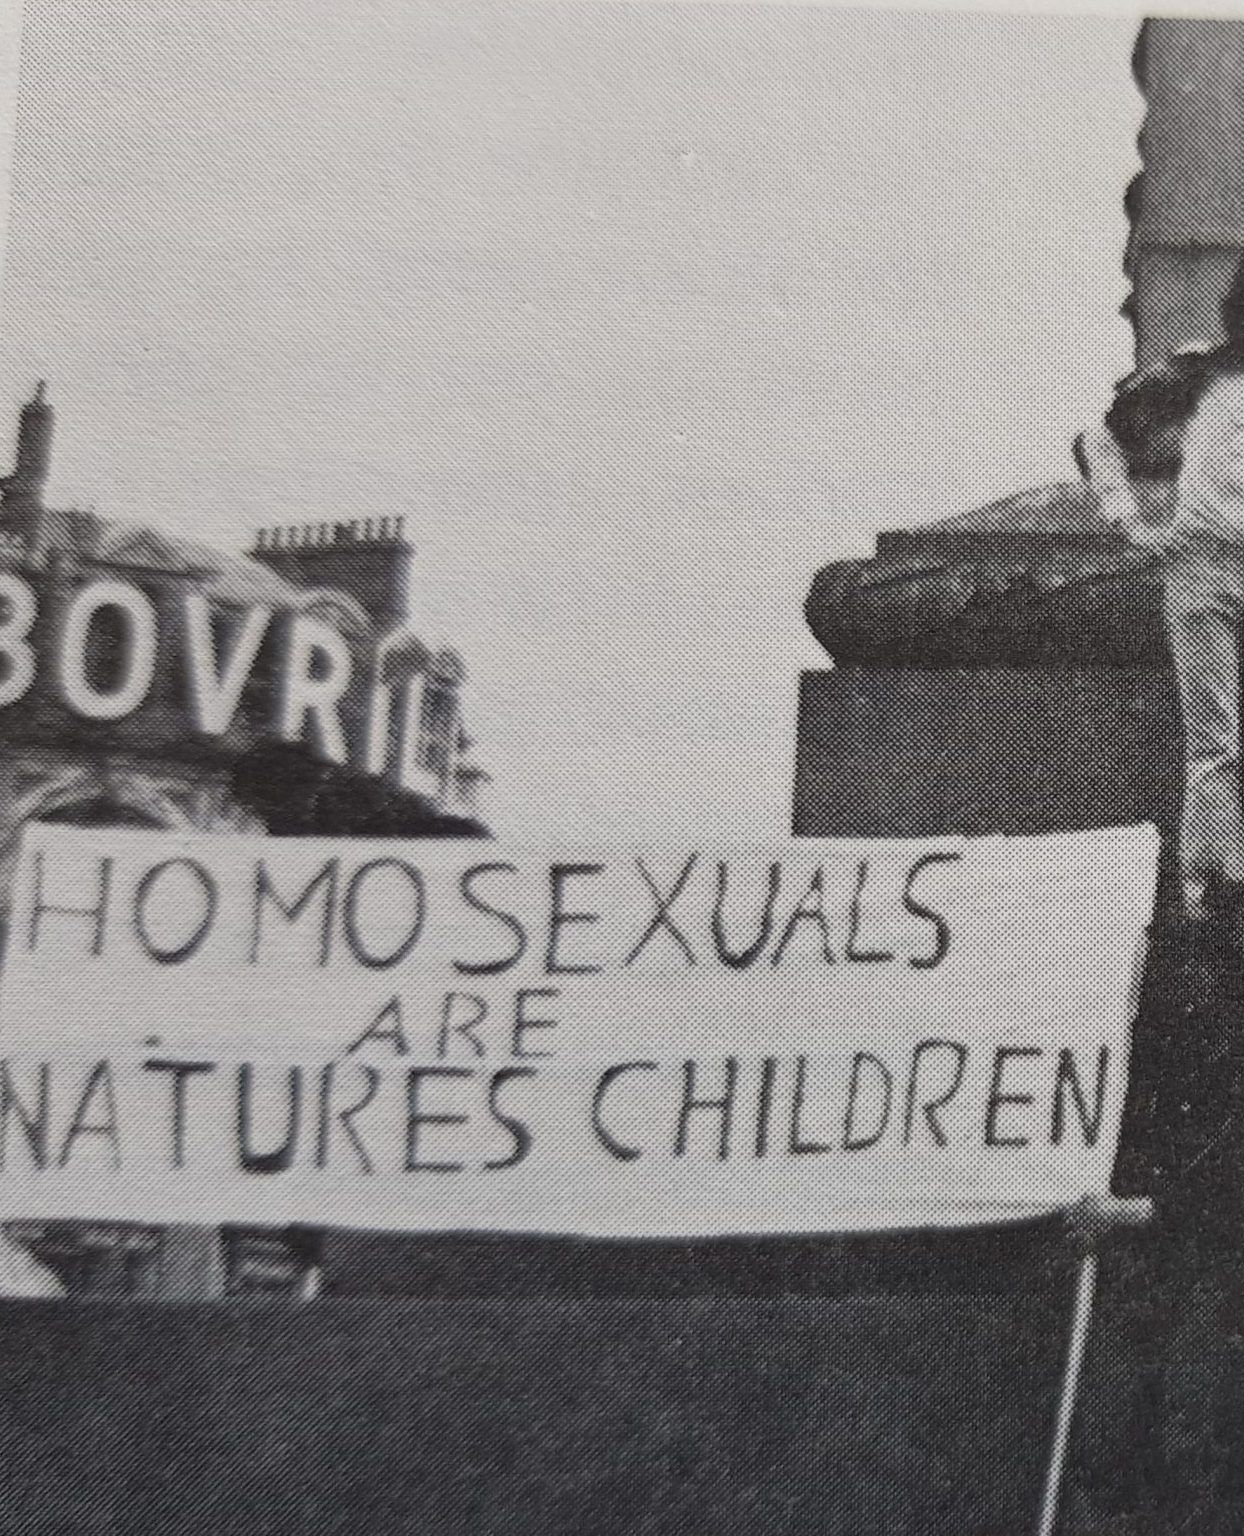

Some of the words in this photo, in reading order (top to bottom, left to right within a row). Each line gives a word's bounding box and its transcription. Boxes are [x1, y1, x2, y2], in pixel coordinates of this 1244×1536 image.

[28, 850, 963, 976] HOMOSEXUALS
[346, 988, 562, 1067] ARE
[0, 1058, 538, 1176] NATURES
[592, 1038, 1109, 1163] CHILDREN
